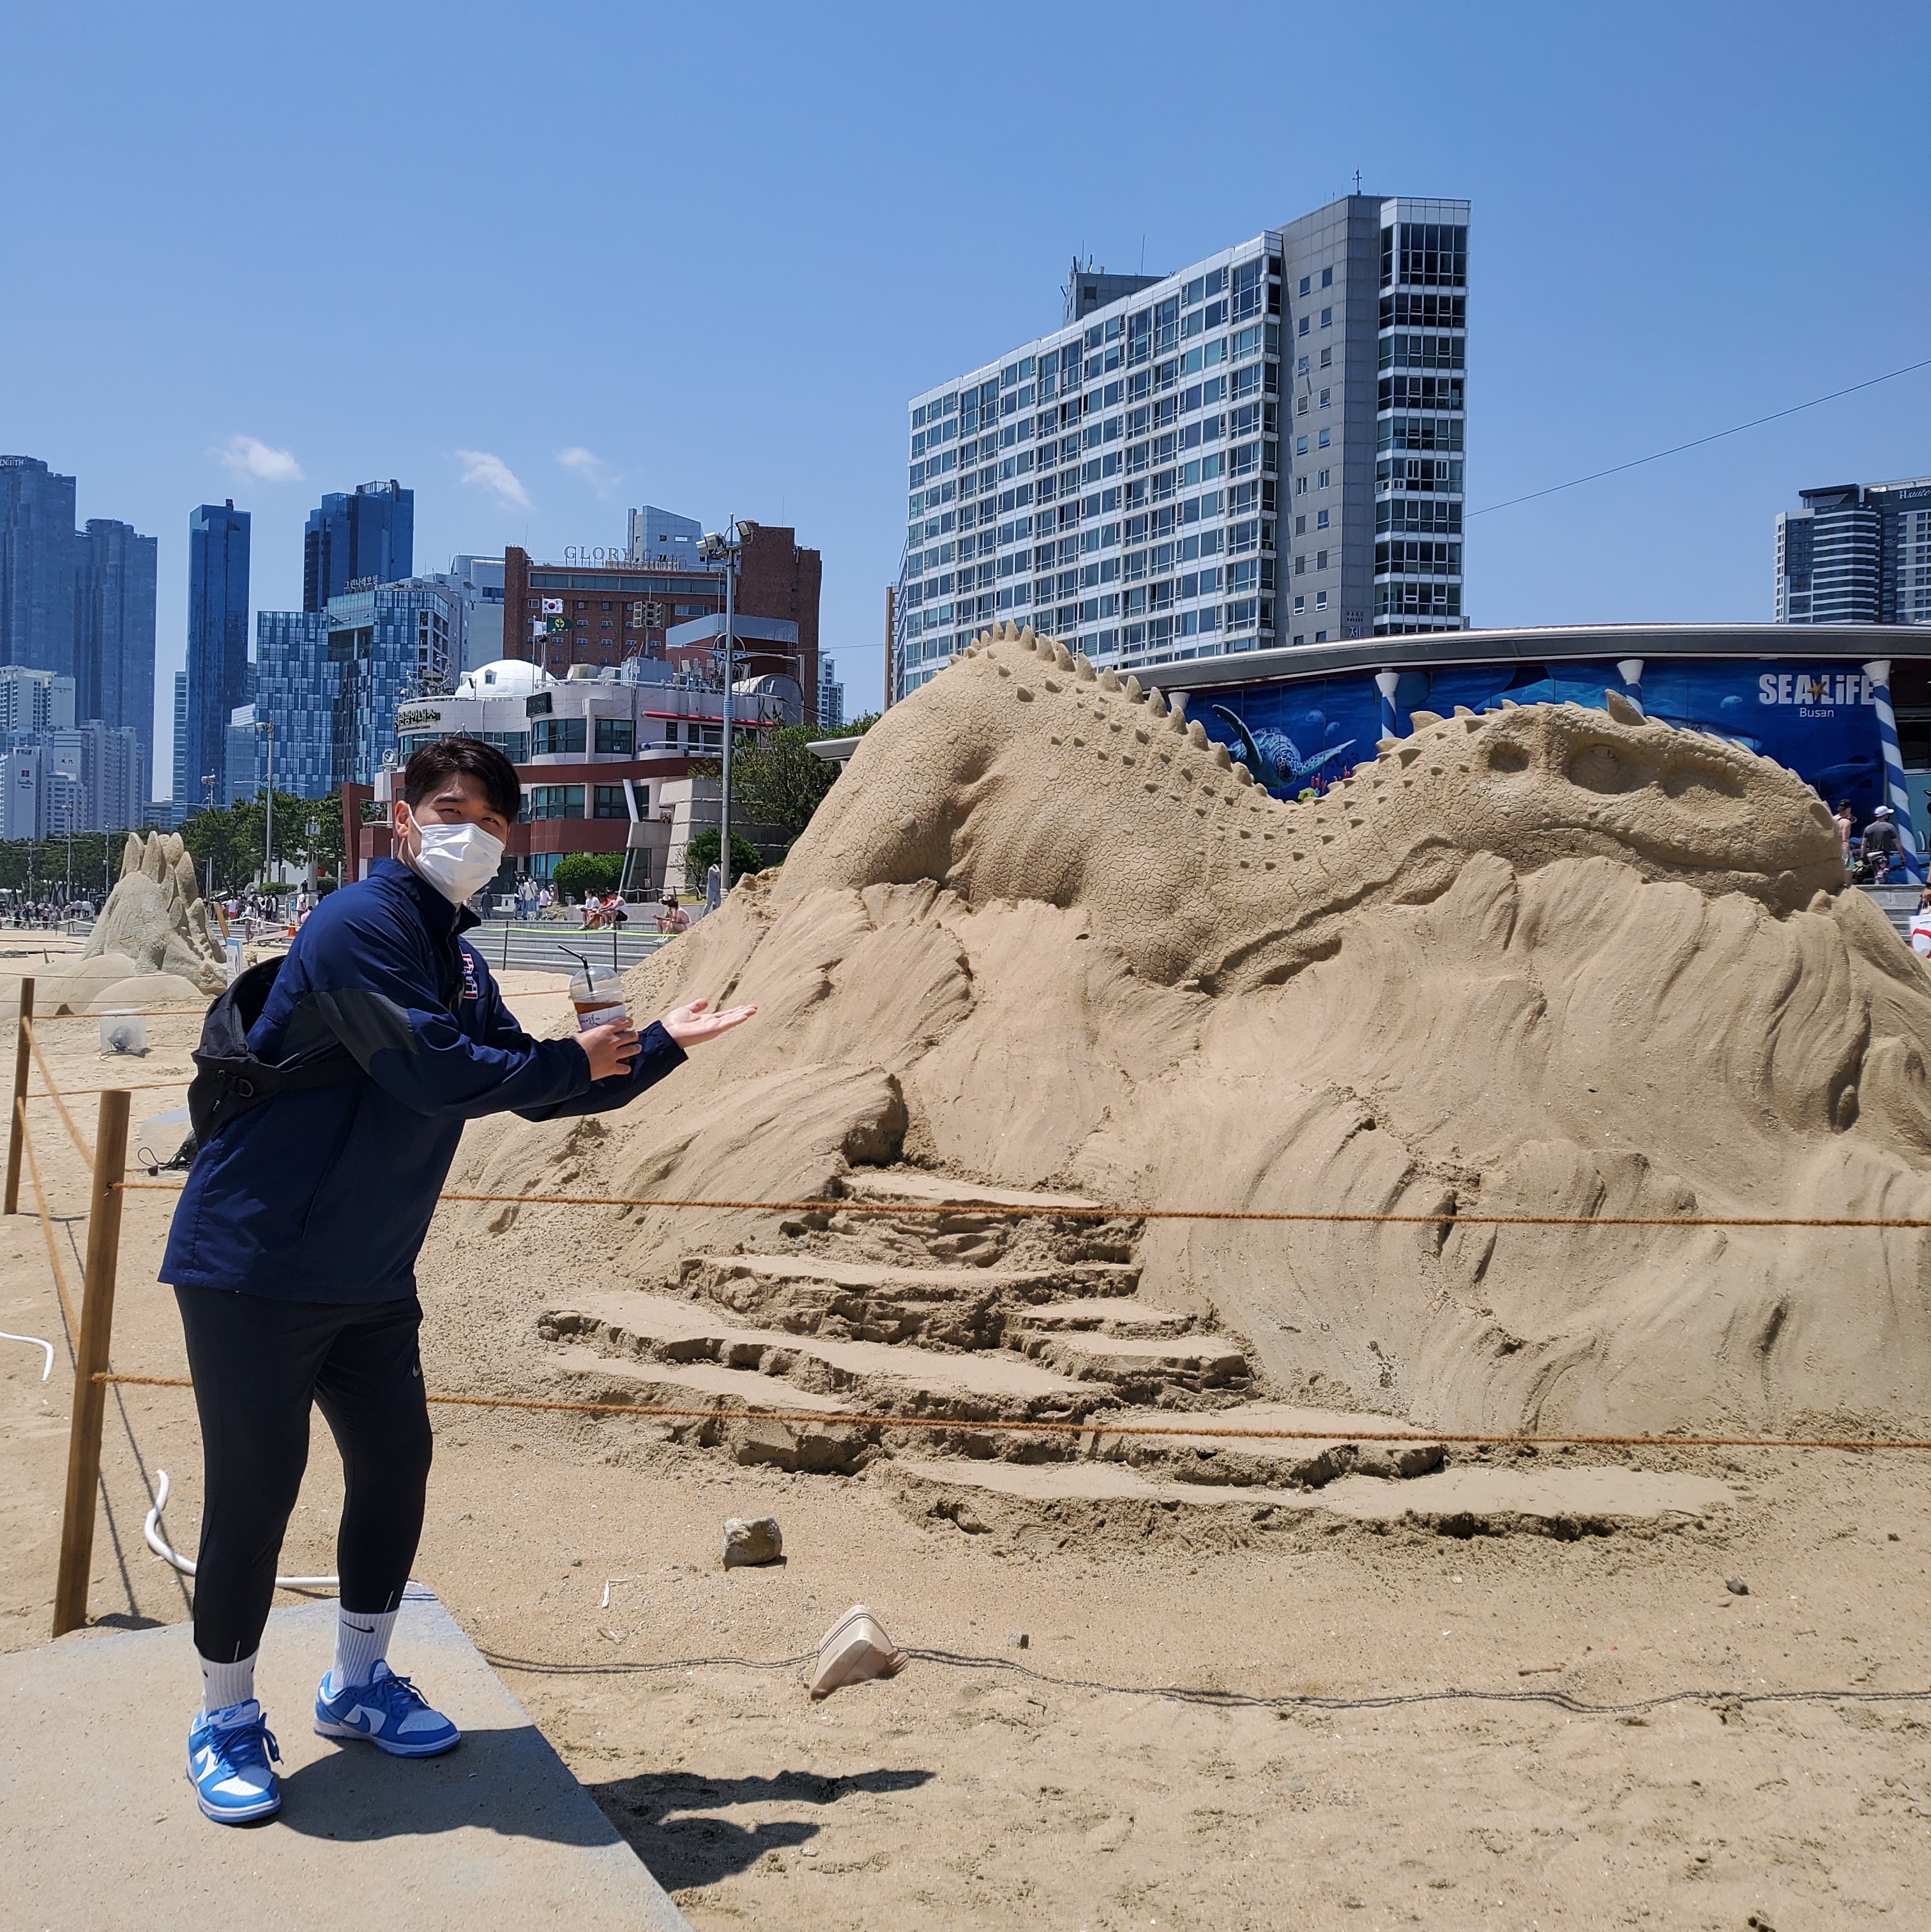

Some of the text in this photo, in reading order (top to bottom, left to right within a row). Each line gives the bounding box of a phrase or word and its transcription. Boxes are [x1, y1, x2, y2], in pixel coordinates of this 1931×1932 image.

[564, 545, 632, 560] GLORY
[1759, 673, 1814, 705] SEA
[1799, 707, 1834, 718] Busan
